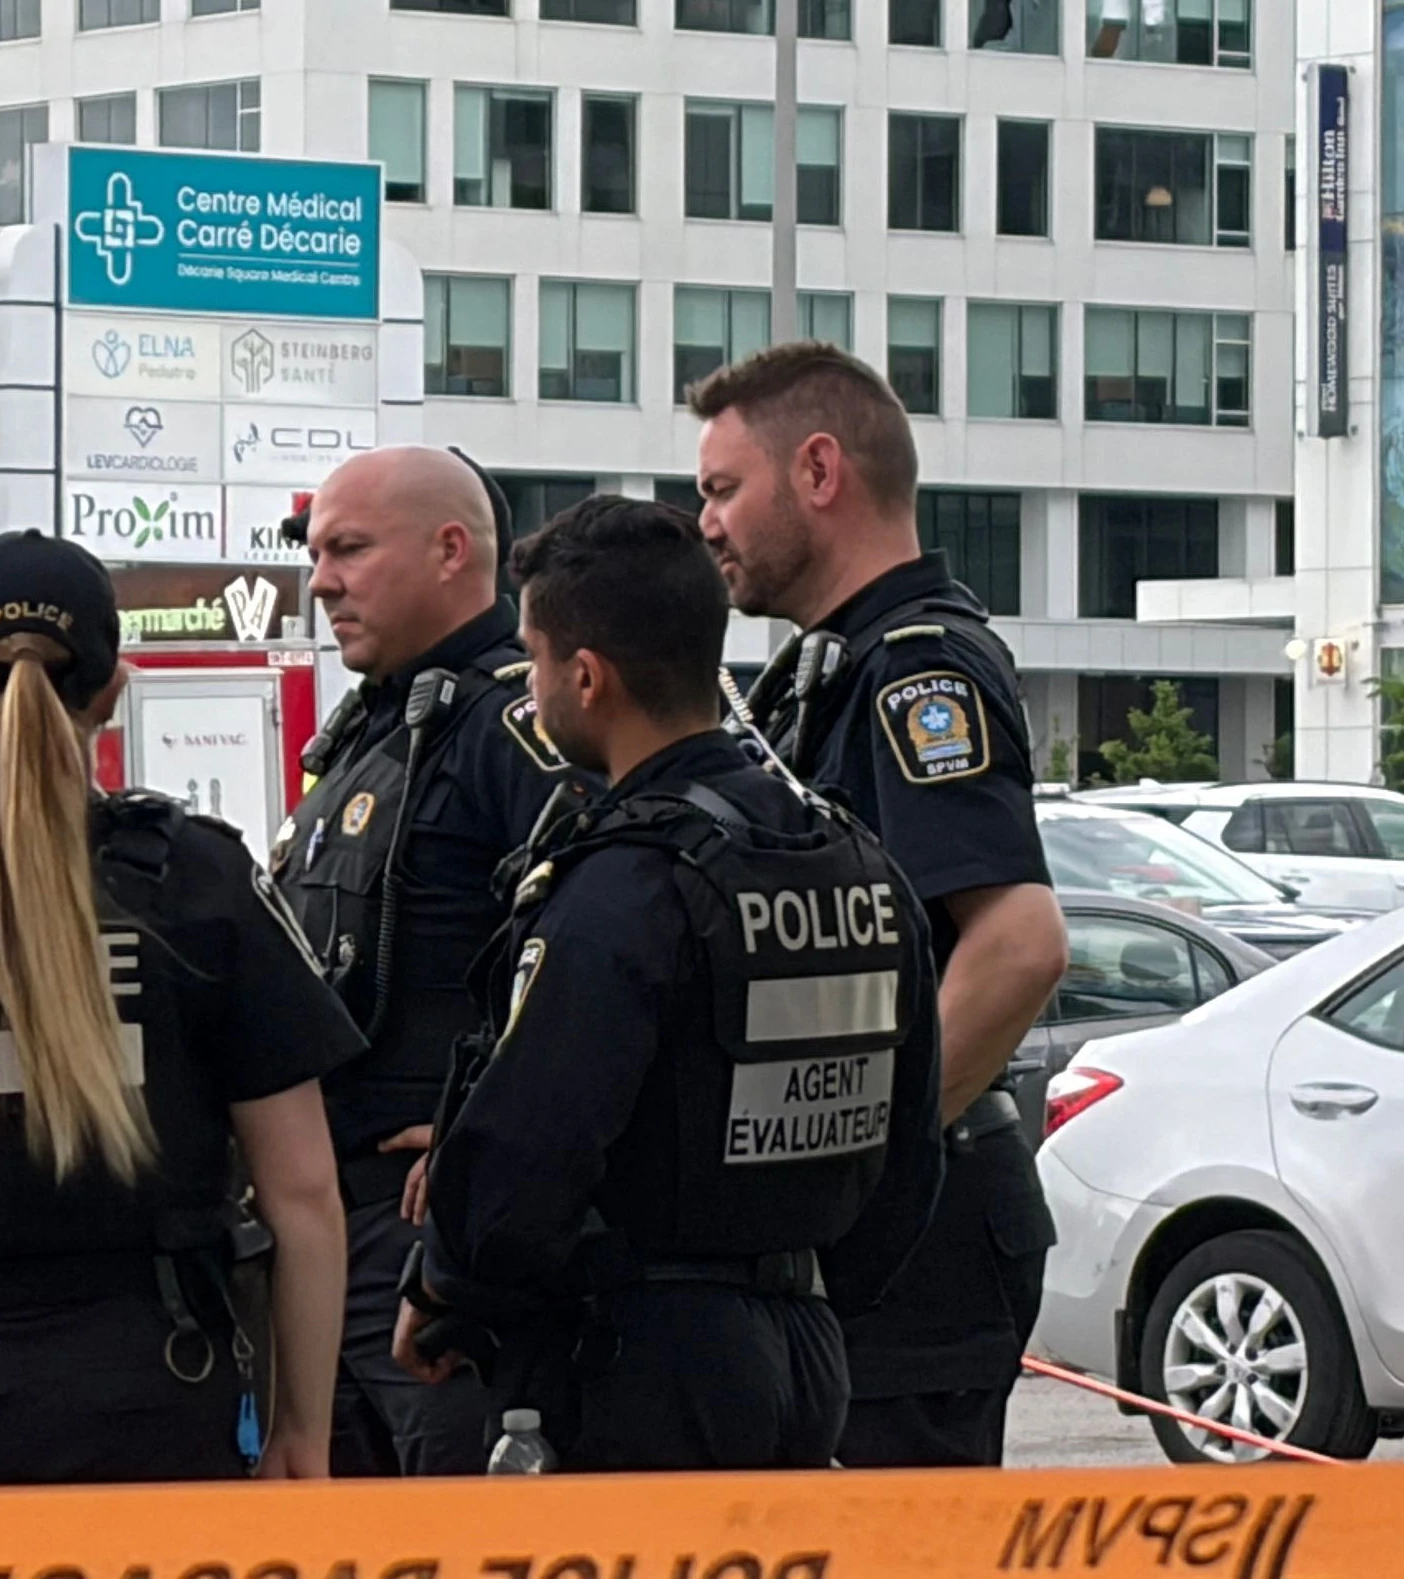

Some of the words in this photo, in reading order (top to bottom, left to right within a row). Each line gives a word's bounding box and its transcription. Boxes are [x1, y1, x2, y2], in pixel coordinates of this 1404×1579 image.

[1321, 130, 1335, 200] Hilton
[177, 186, 261, 215] Centre
[267, 191, 362, 222] Médical
[177, 220, 253, 249] Carré
[260, 226, 362, 256] Décarie
[227, 266, 269, 283] Square
[271, 268, 318, 285] Medical
[321, 271, 361, 287] Centre
[138, 333, 196, 359] ELNA
[281, 341, 373, 362] STEINBERG
[281, 363, 336, 384] SANTÉ
[271, 427, 374, 450] CDL
[86, 453, 199, 473] LEVCARDIOLOGIE
[887, 678, 969, 711] POLICE
[926, 757, 970, 776] SPVM
[736, 883, 899, 953] POLICE
[784, 1056, 869, 1104] AGENT
[728, 1100, 888, 1156] ÉVALUATEUR
